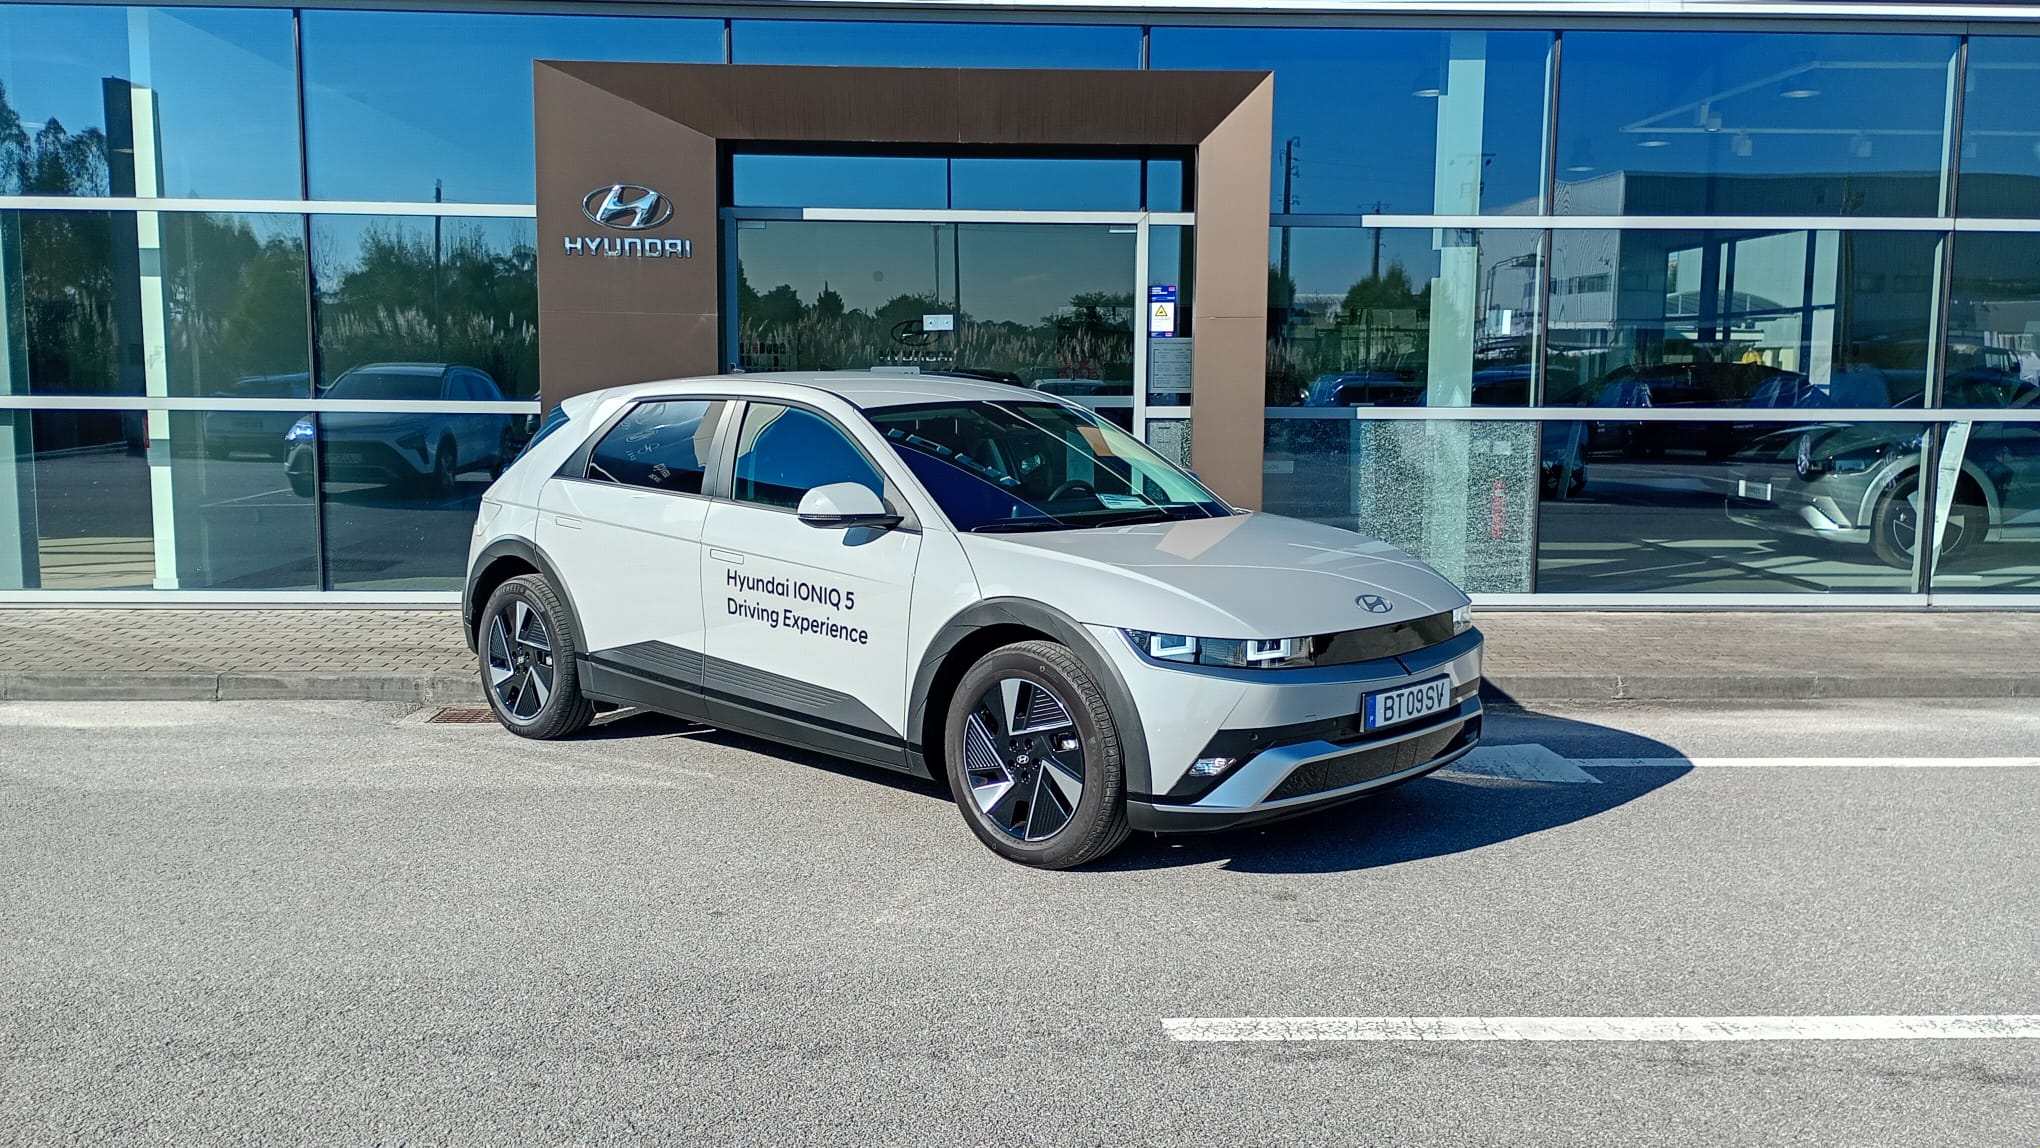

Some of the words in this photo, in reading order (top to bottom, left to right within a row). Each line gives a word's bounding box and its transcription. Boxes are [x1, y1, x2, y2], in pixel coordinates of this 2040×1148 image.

[562, 236, 692, 258] HYUNDAI
[726, 568, 790, 598] Hyundai
[793, 580, 841, 611] IONIQ
[844, 591, 855, 610] 5
[727, 597, 779, 628] Driving
[783, 609, 868, 645] Experience
